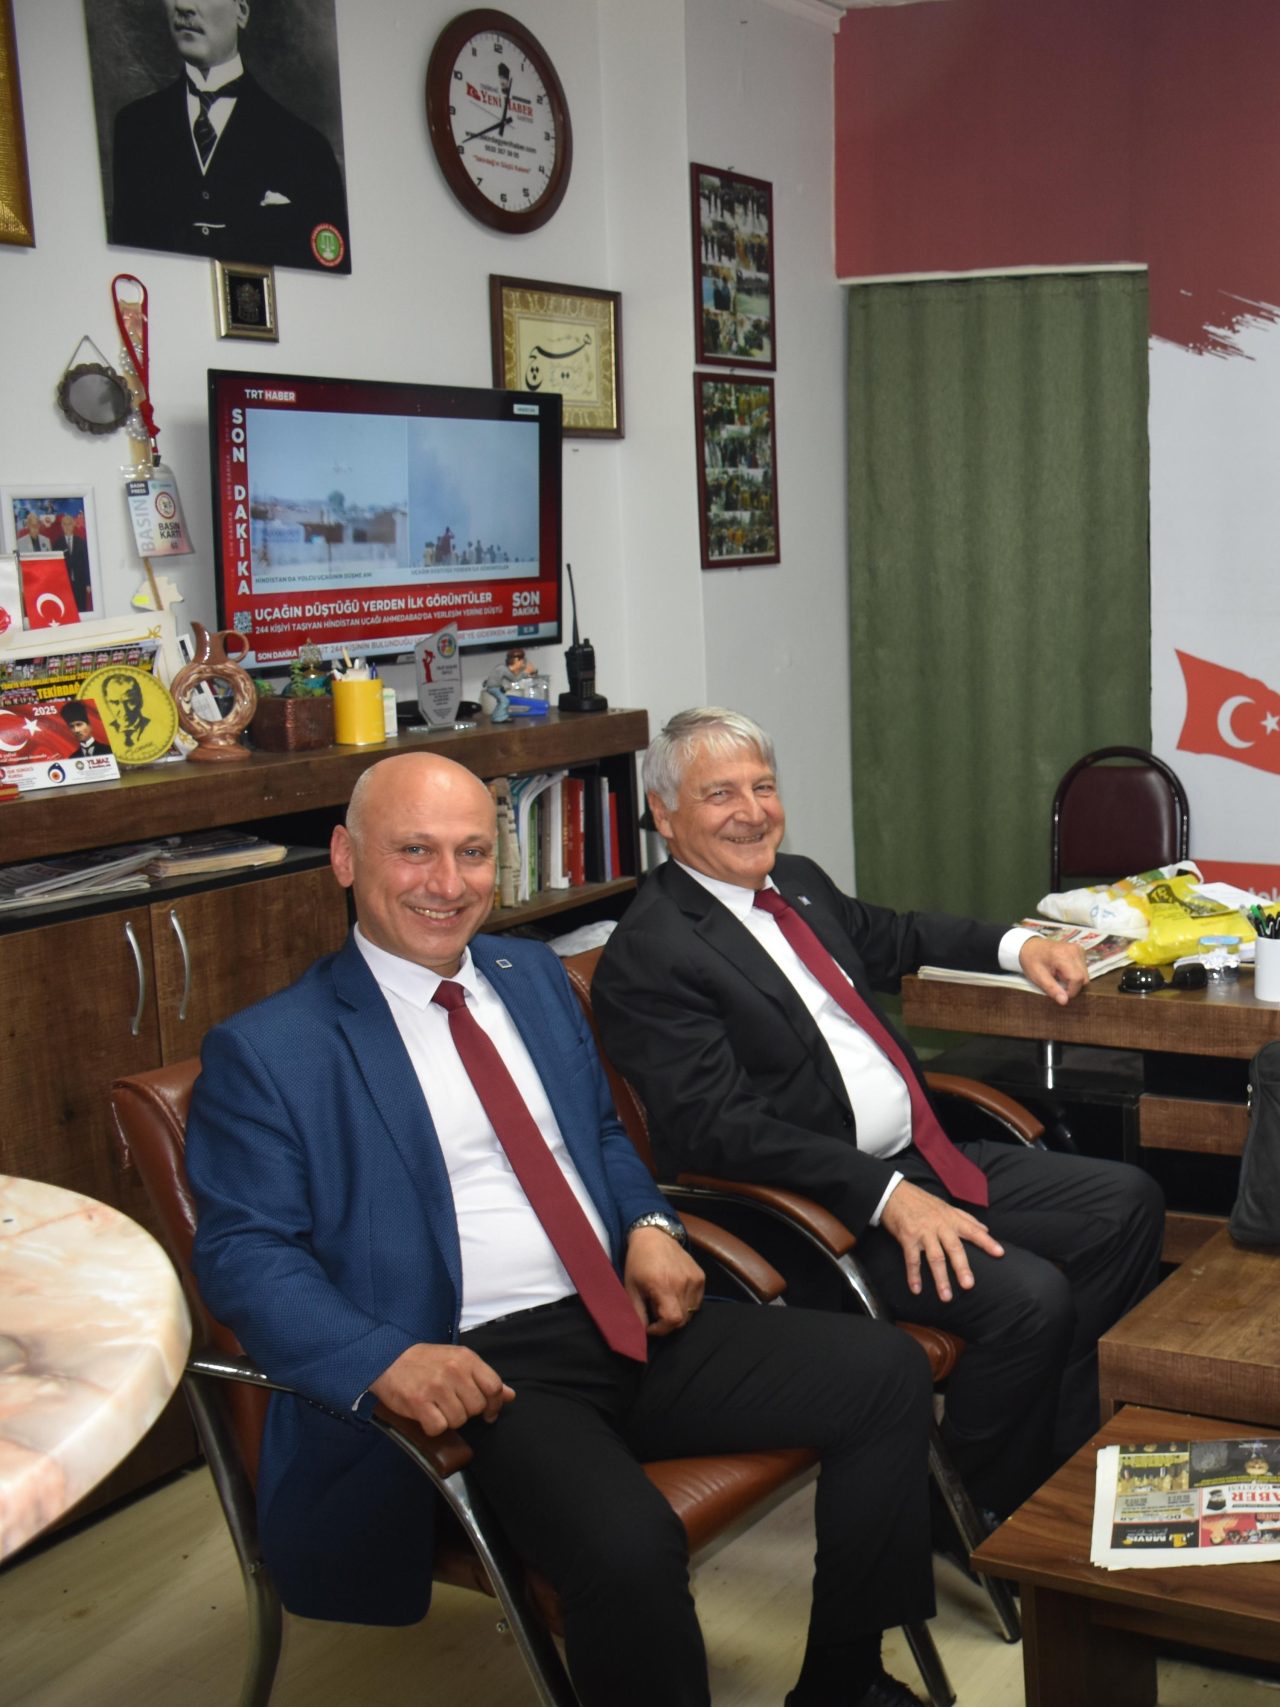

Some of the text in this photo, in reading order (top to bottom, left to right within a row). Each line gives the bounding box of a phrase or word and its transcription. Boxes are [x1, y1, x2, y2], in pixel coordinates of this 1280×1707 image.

[244, 389, 296, 401] TRT HABER
[512, 591, 540, 606] SON
[255, 591, 493, 622] UÇAĞIN DÜŞTÜĞÜ YERDEN İLK GÖRÜNTÜLER
[512, 606, 540, 617] DAKİKA
[292, 622, 322, 632] TAŞIYAN
[257, 648, 297, 660] SON DAKİKA
[33, 705, 57, 717] 2025
